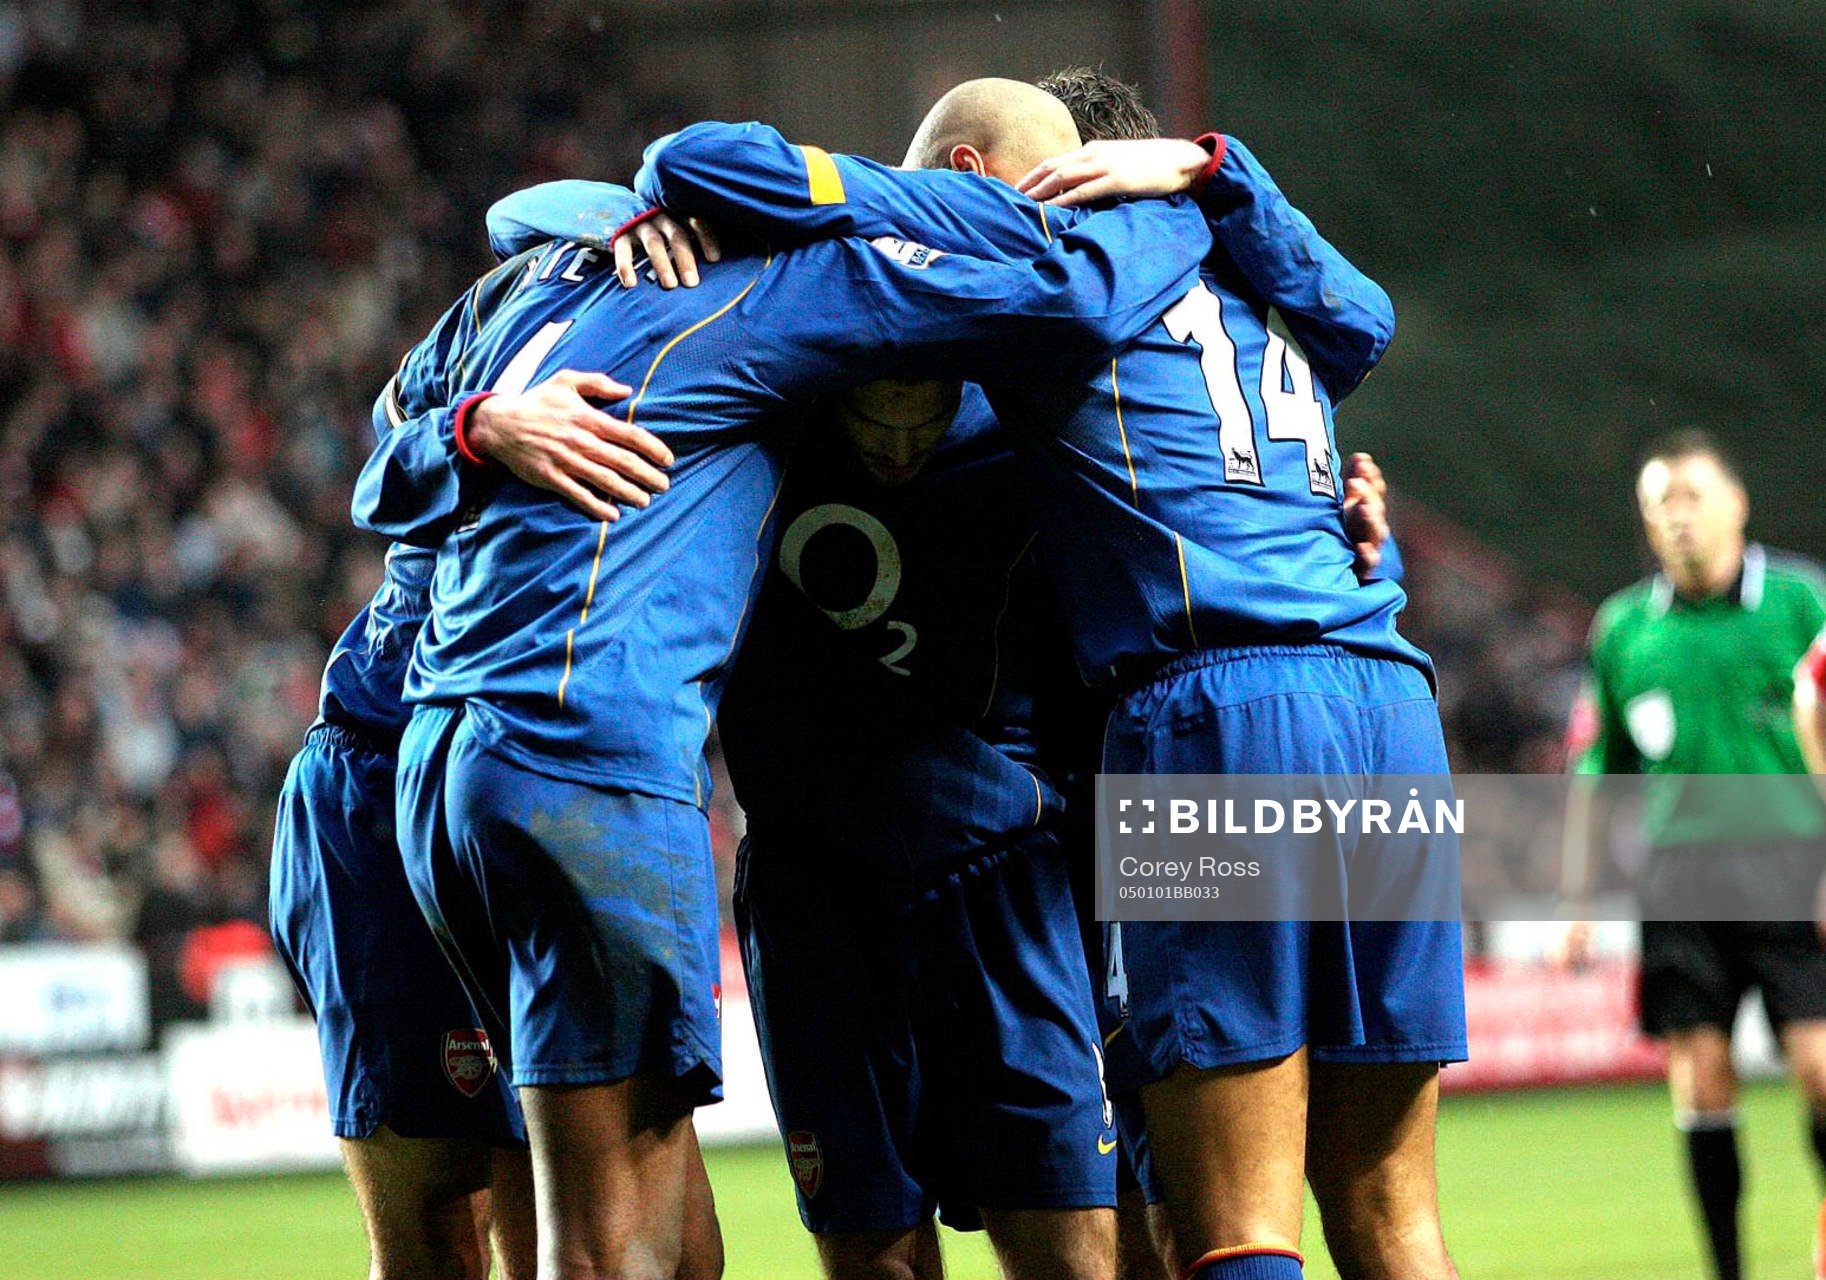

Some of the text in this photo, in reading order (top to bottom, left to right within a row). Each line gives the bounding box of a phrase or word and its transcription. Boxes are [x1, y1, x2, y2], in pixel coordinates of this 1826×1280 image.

[1161, 278, 1337, 498] 14
[778, 503, 919, 677] O2
[448, 1038, 490, 1051] Arsenal
